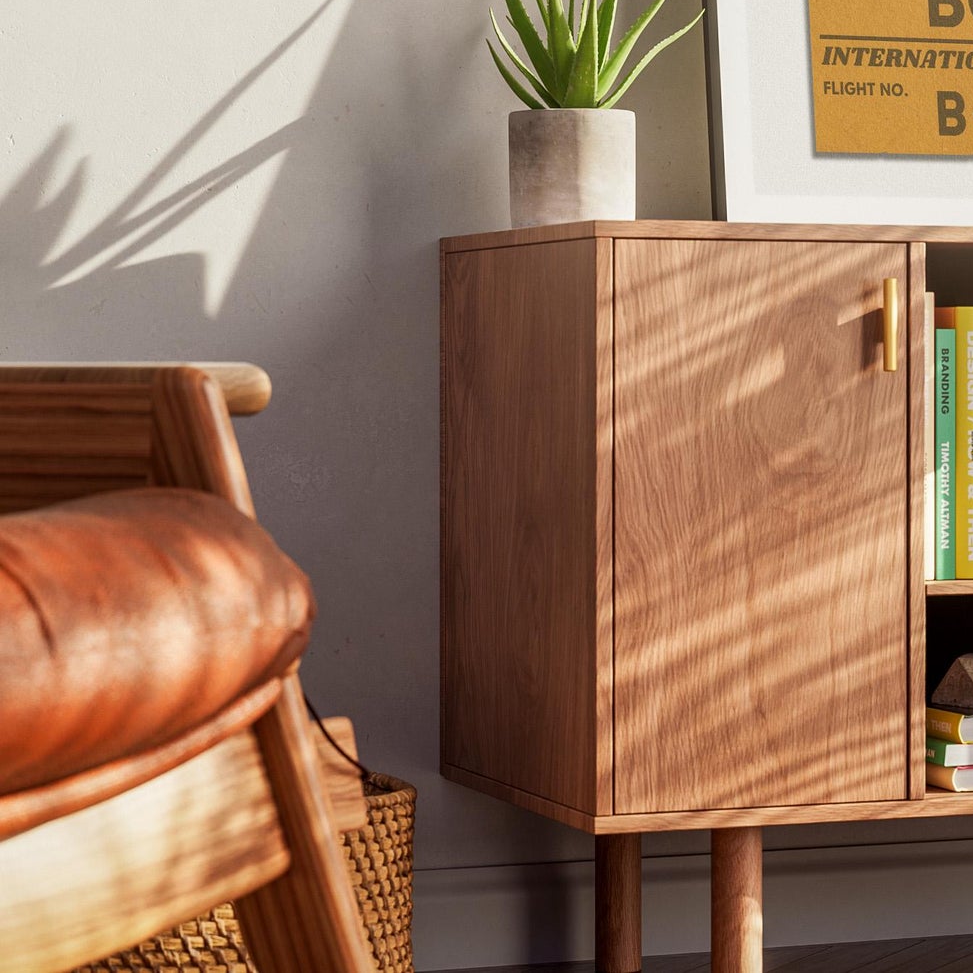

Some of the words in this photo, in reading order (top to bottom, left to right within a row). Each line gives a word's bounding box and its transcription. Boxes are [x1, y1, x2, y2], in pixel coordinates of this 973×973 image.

[823, 80, 876, 97] FLIGHT
[879, 82, 909, 98] NO.
[941, 348, 950, 415] BRANDING
[941, 441, 950, 496] TIMOTHY
[940, 499, 950, 550] ALTMAN
[931, 719, 952, 734] THEN
